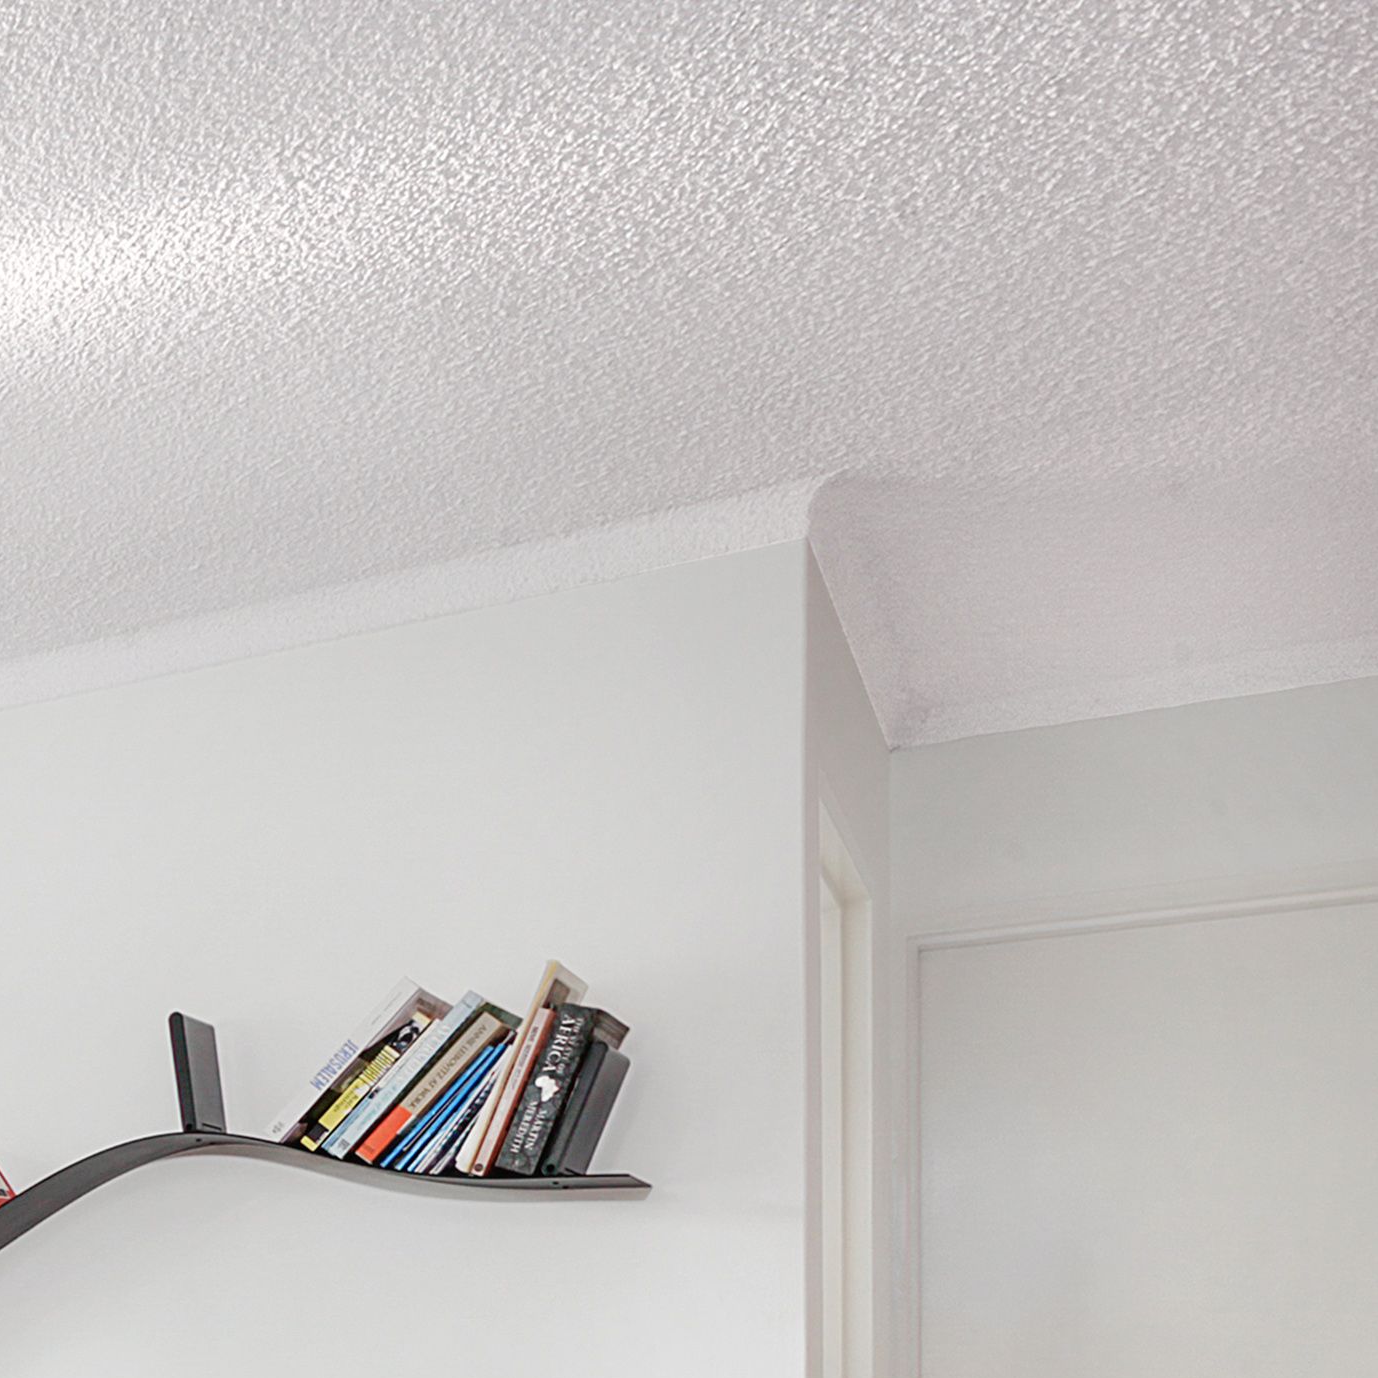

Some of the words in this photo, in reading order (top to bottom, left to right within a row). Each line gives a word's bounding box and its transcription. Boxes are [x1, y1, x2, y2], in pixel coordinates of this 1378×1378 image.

[465, 1023, 488, 1047] ANNIE
[541, 1014, 576, 1073] AFRICA
[309, 1038, 359, 1091] JERUSALEM
[435, 1044, 468, 1079] LEIBOVITZ
[408, 1086, 430, 1109] WORK
[426, 1077, 438, 1089] AT
[509, 1100, 538, 1153] MEREDITH
[523, 1108, 547, 1151] MARTIN
